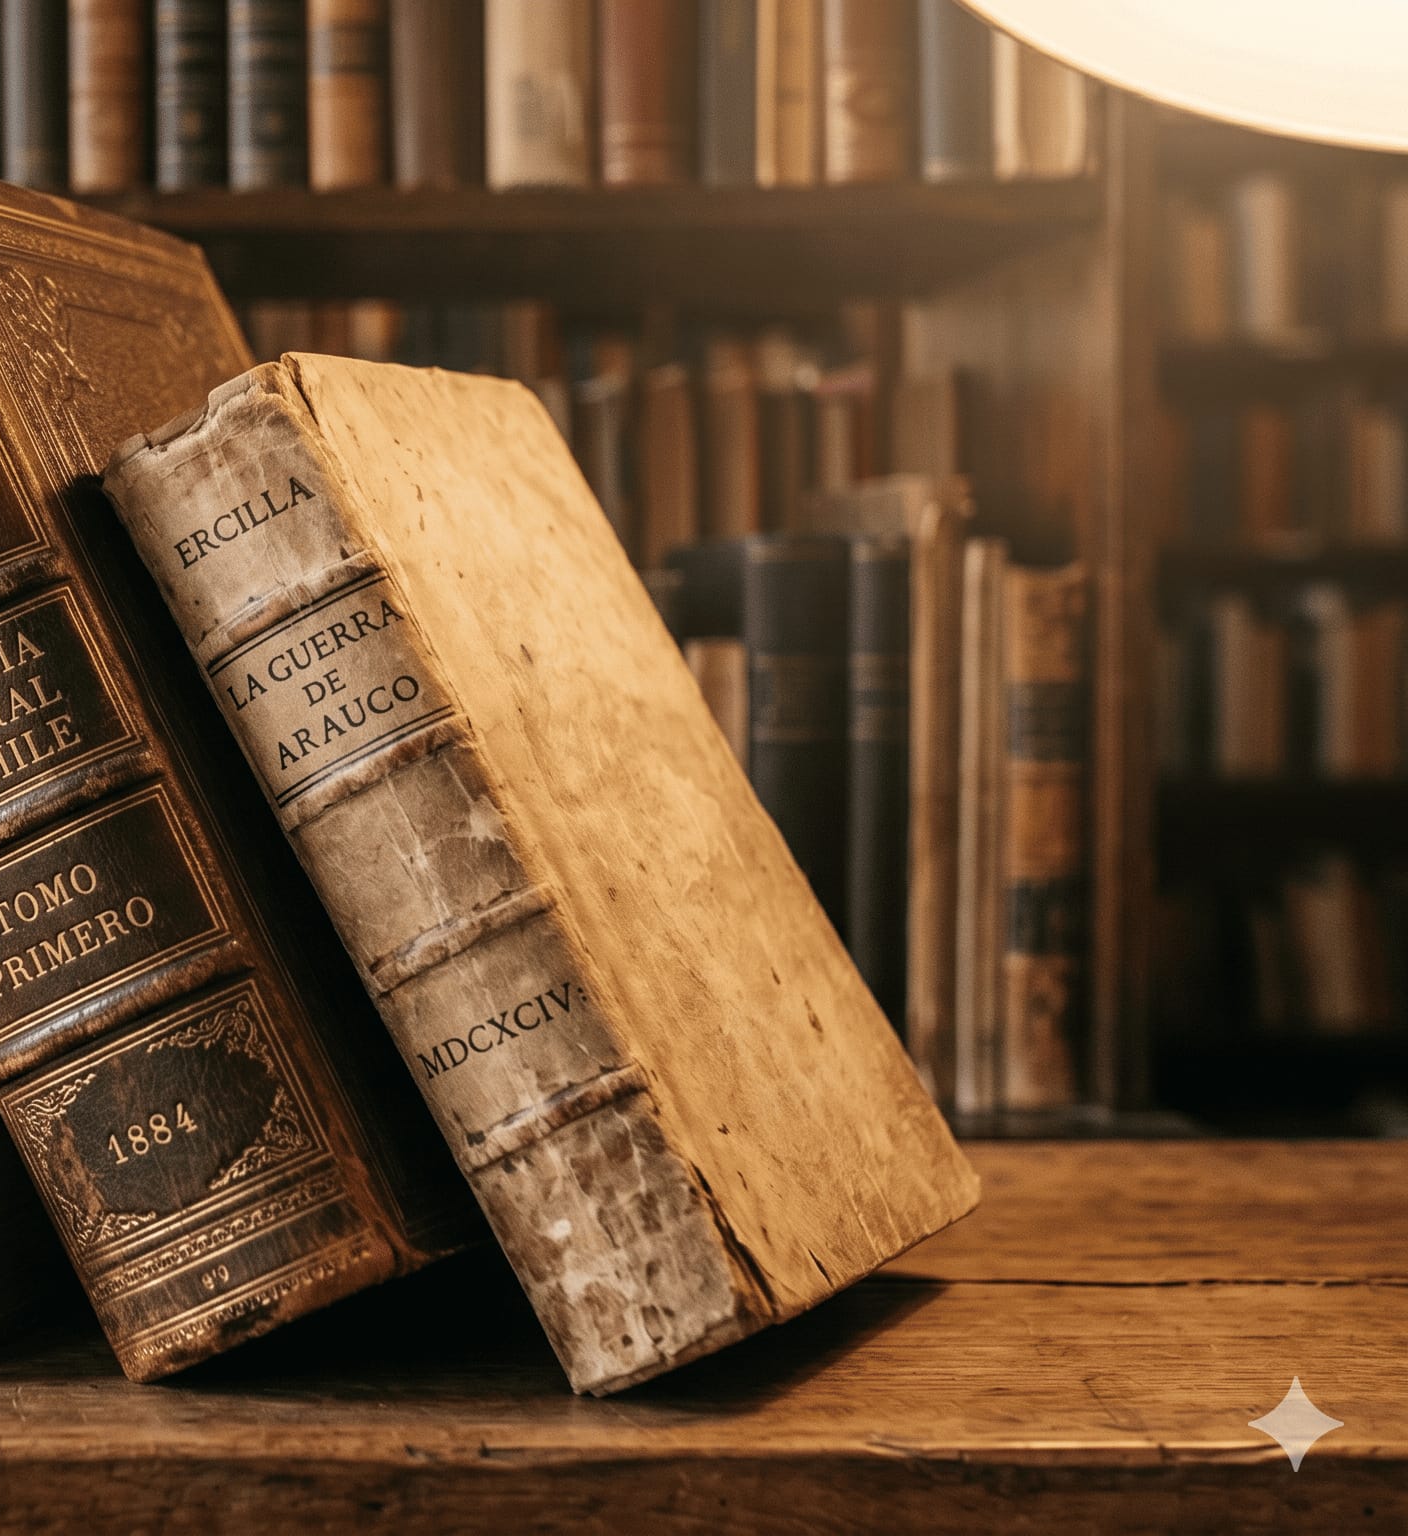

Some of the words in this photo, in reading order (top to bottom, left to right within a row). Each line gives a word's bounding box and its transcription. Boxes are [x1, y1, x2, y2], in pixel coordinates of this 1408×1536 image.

[173, 476, 316, 569] ERCILLA
[226, 673, 268, 711] LA
[268, 600, 405, 682] GUERRA
[302, 668, 347, 706] DE
[276, 675, 419, 770] ARAUCO
[107, 1102, 198, 1164] 1884
